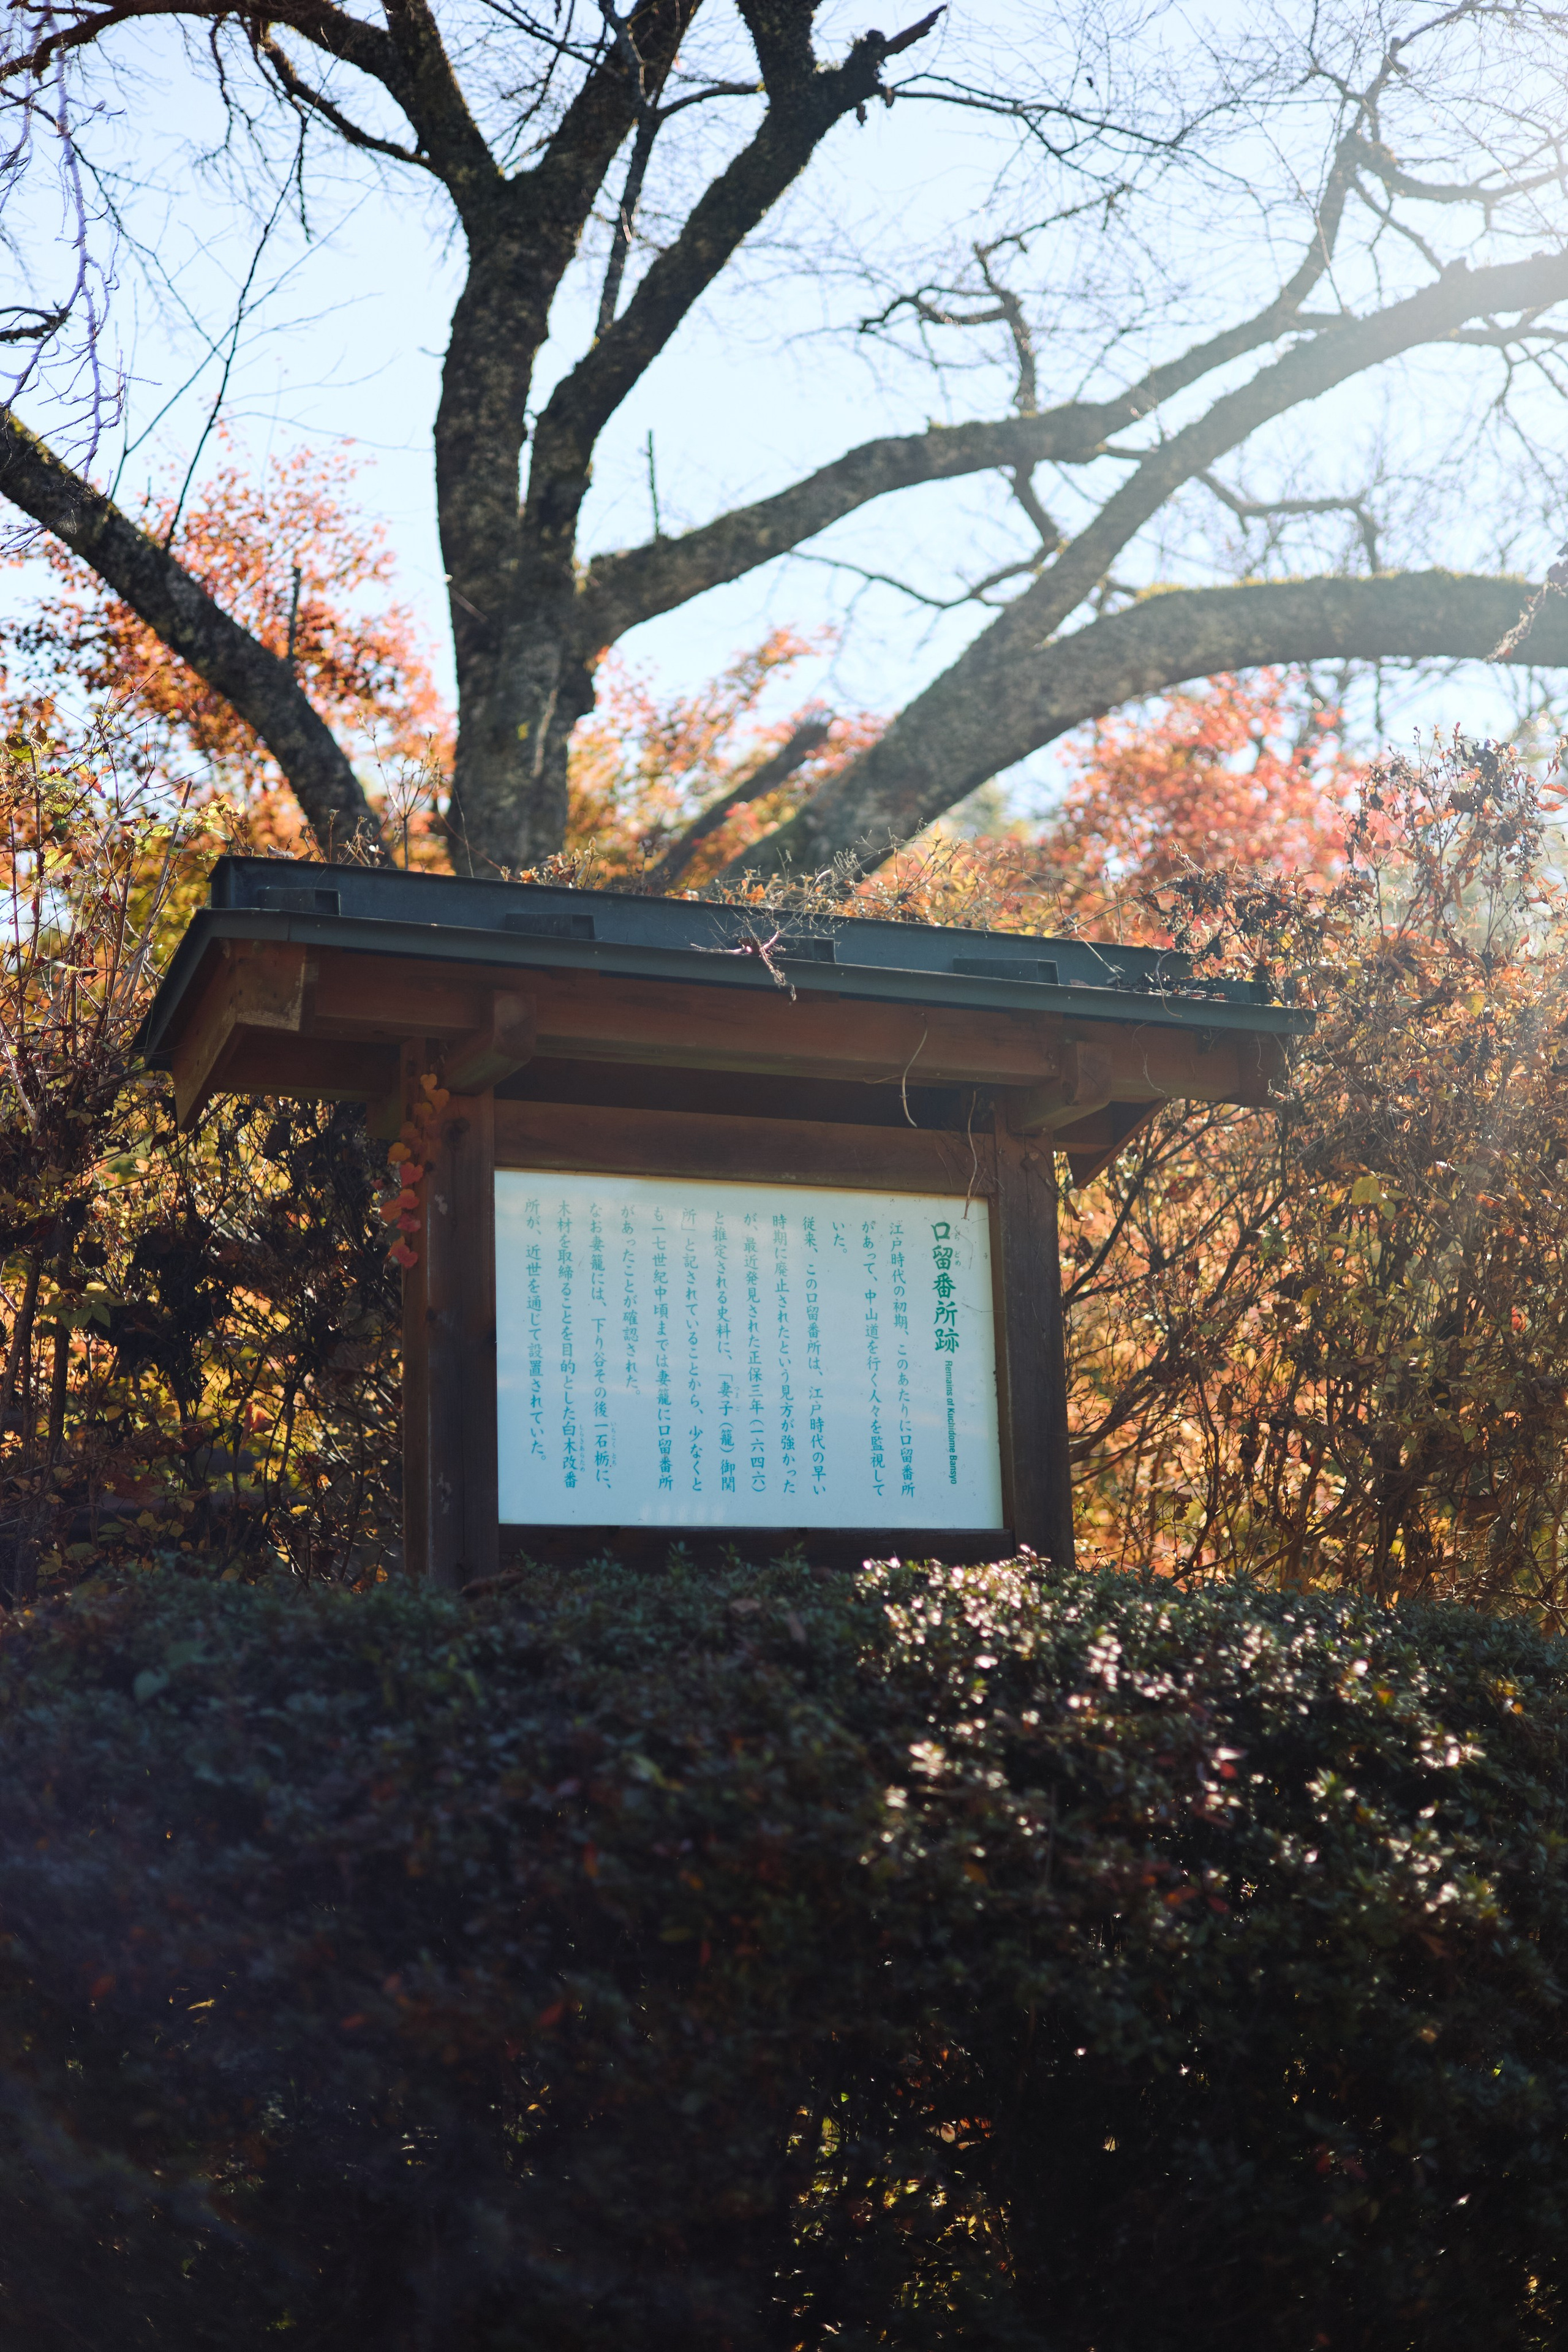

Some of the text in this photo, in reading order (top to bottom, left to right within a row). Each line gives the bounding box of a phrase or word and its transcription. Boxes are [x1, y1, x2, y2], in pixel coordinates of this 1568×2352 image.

[524, 1198, 546, 1461] 所が、近世を通じて設置されていた。
[556, 1200, 578, 1489] 木材を取締ることを目的とした白木改番
[589, 1202, 611, 1489] なお妻籠には、下り谷その後一石栃に、
[621, 1205, 641, 1395] があったことが確認された。
[652, 1207, 674, 1491] も一七世紀中頃までは妻籠に口留番所
[680, 1208, 704, 1492] 所」と記されていることから、少なくと
[772, 1214, 797, 1494] 時期に廃止されたという見方が強かった
[802, 1216, 827, 1495] 従来、この口留番所は、江戸時代の早い
[832, 1221, 848, 1254] いた。
[862, 1221, 886, 1496] があって、中山道を行く人々を監視して
[890, 1223, 916, 1498] 江戸時代の初期、このあたりに口留番所
[930, 1221, 960, 1354] 口留番所跡
[947, 1408, 956, 1453] Kuchidome
